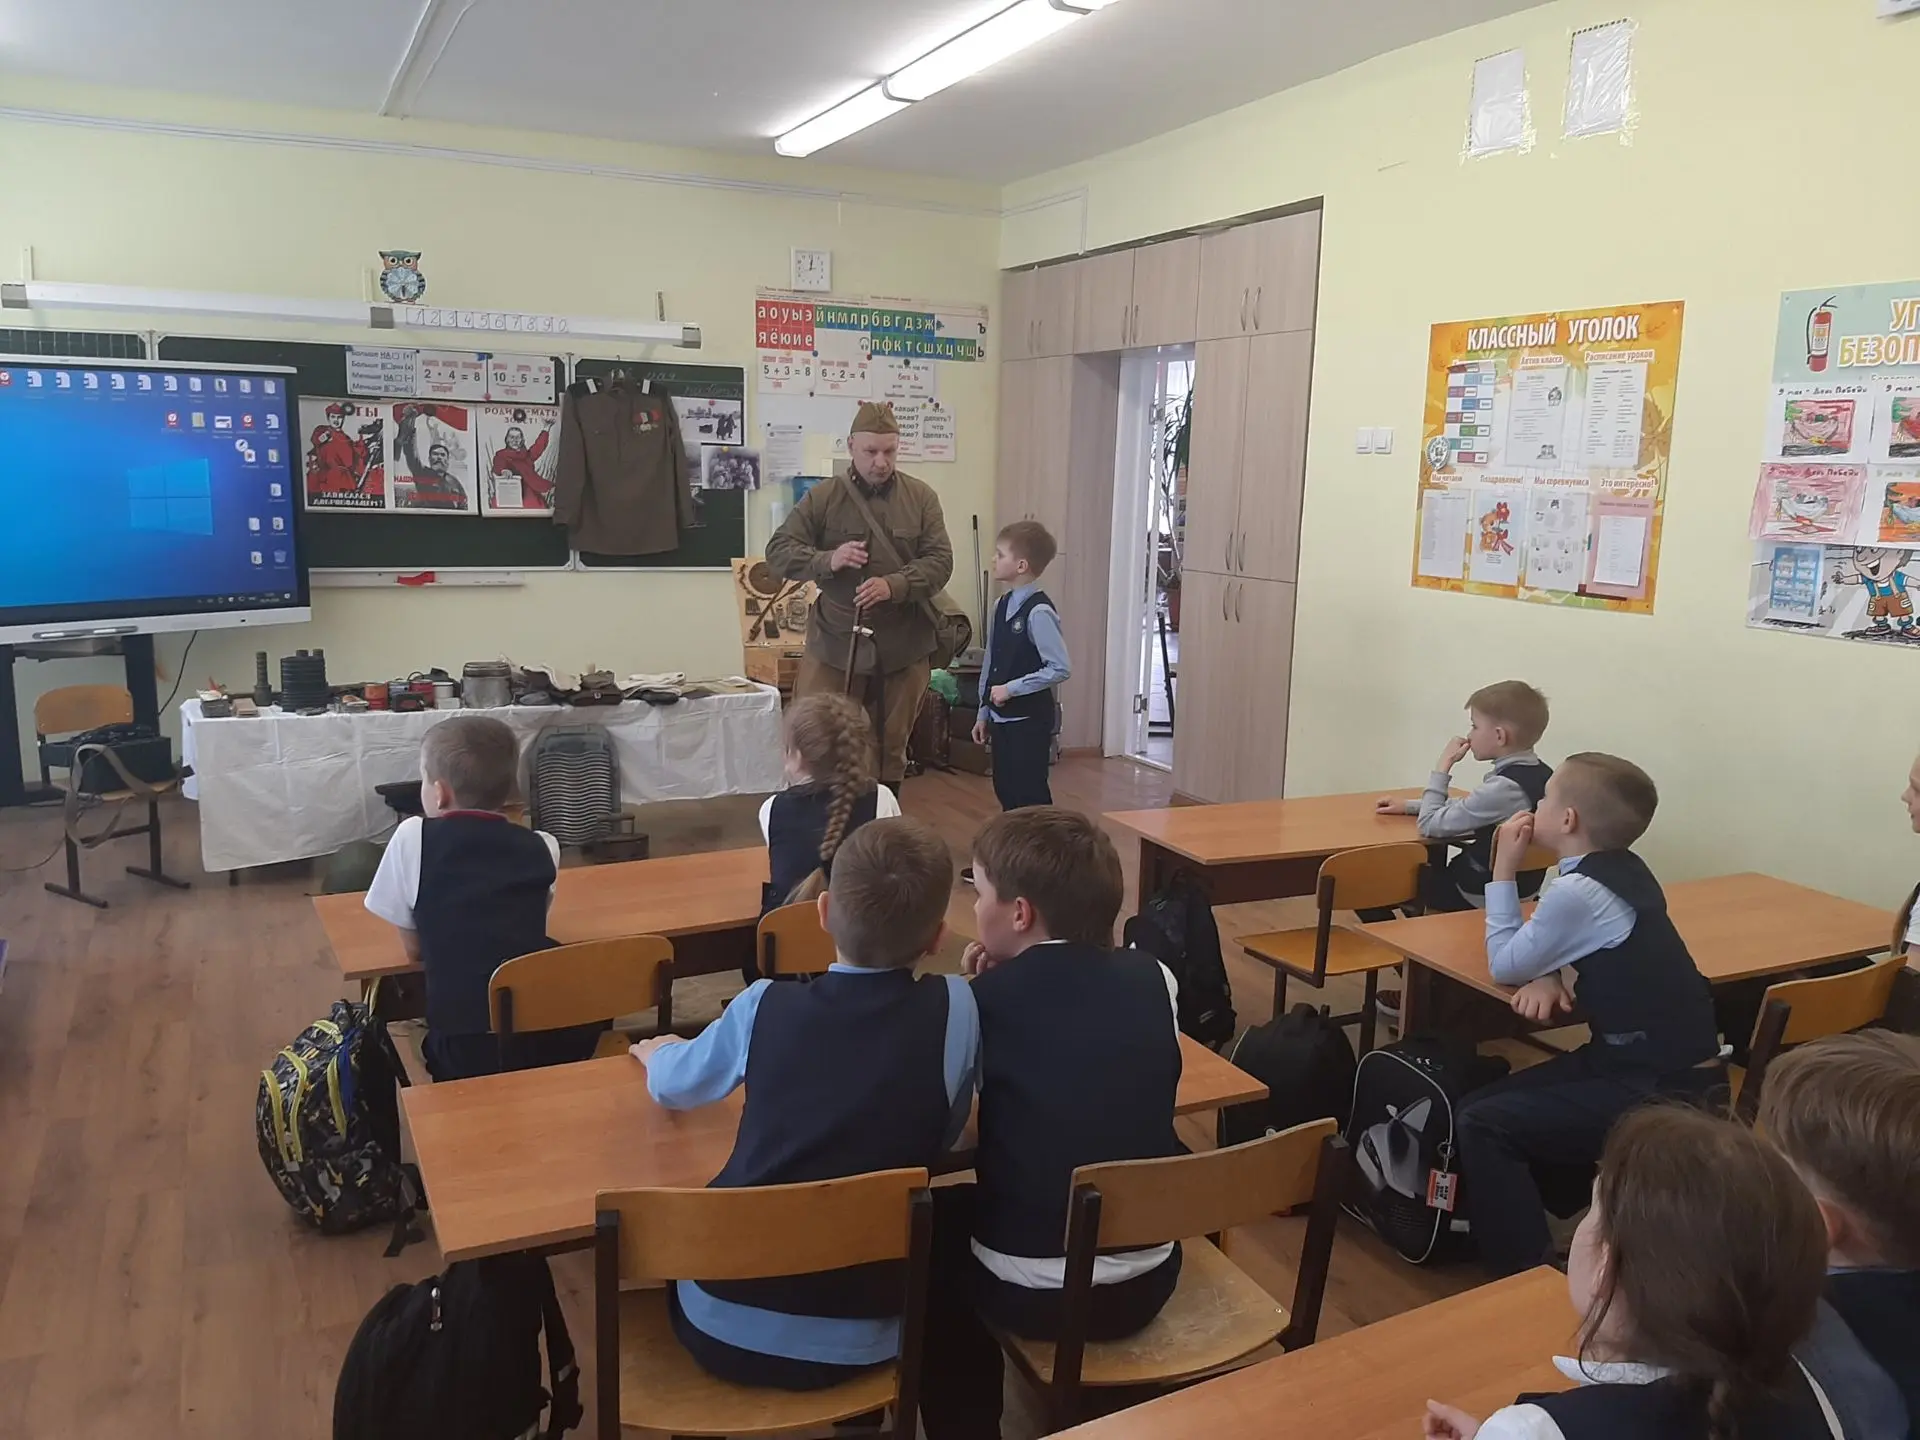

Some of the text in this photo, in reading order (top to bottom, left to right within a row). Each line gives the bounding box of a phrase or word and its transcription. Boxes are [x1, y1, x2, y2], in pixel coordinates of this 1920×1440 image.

[1467, 314, 1640, 351] КЛАССНЫЙ УГОЛОК
[1585, 351, 1625, 362] Расписание
[1838, 333, 1920, 367] БЕЗОП
[493, 371, 506, 382] 10
